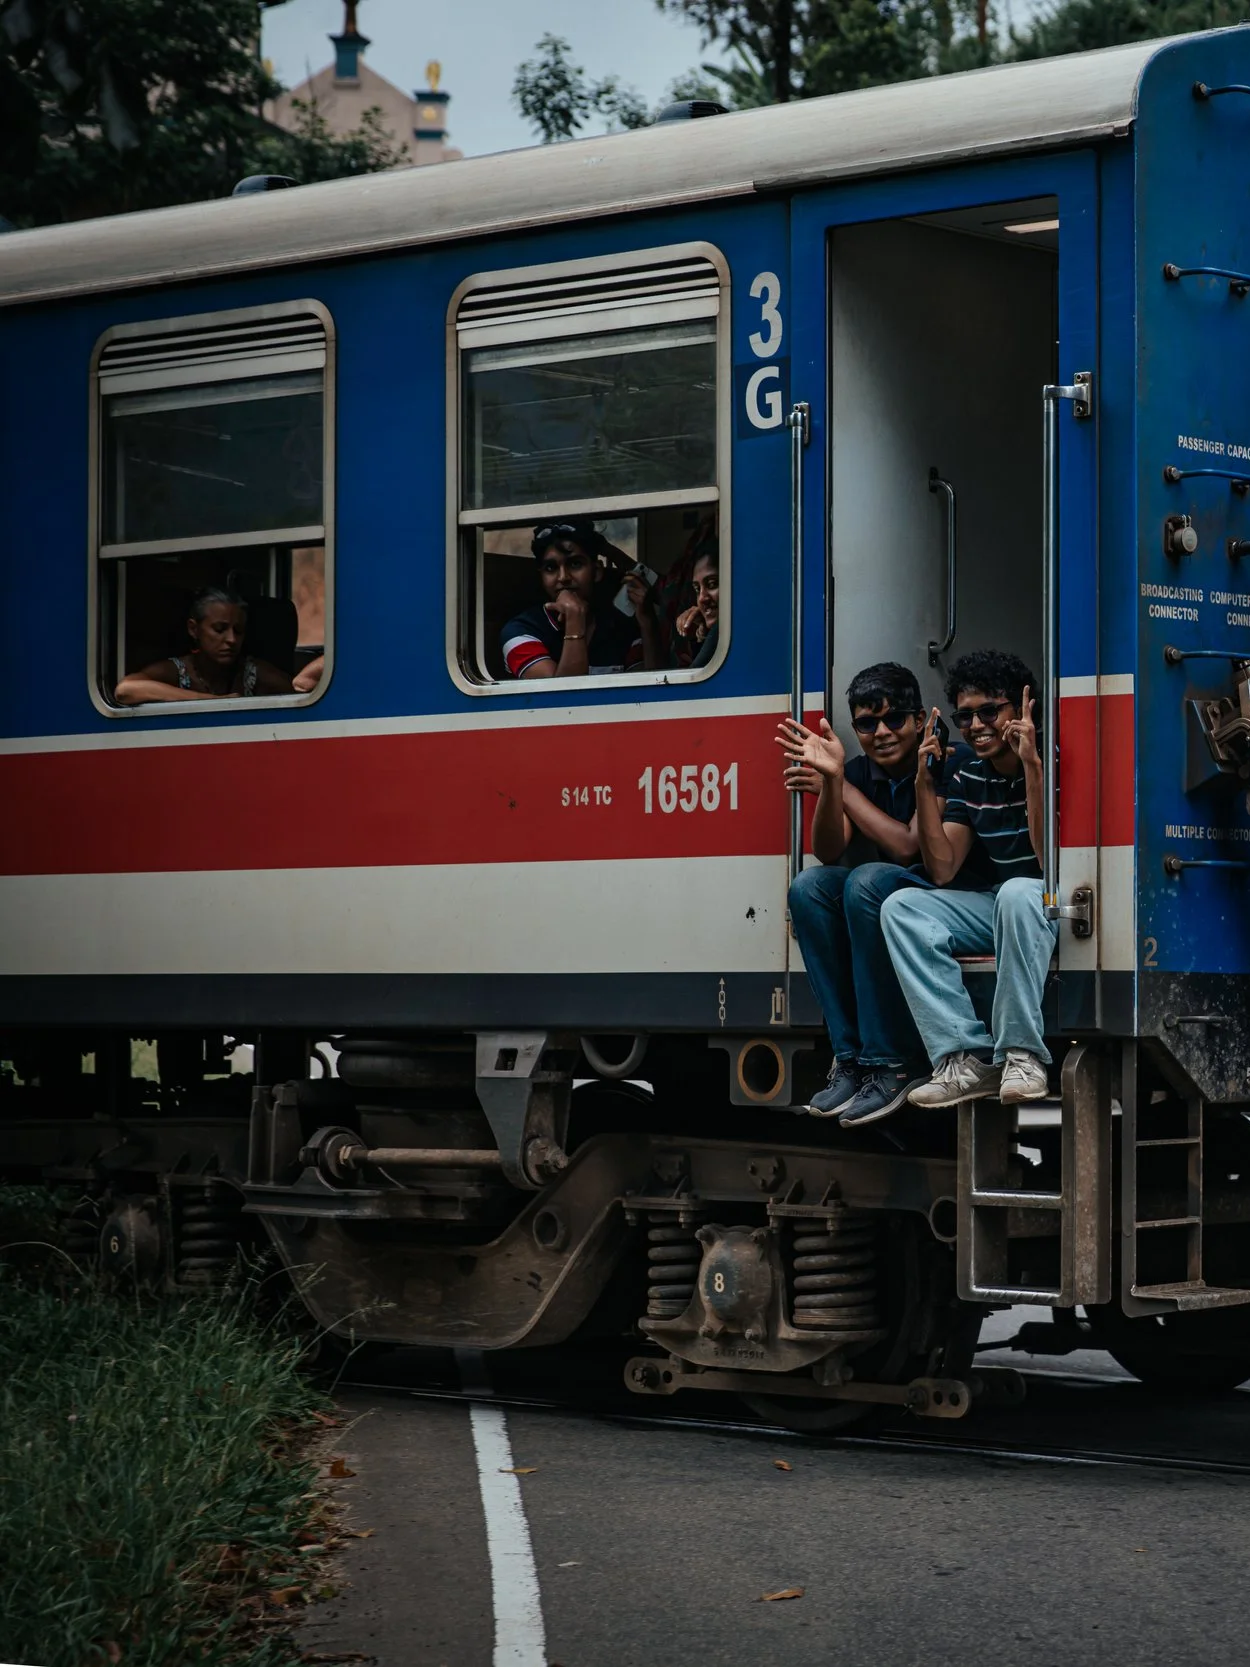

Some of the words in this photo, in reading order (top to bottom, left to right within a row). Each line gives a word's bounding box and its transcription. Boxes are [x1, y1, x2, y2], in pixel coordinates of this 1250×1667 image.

[748, 271, 783, 358] 3
[745, 365, 783, 430] G
[1177, 434, 1225, 456] PASSENGER
[1140, 583, 1204, 603] BROADCASTING
[1149, 603, 1199, 623] CONNECTOR
[593, 785, 612, 806] TC
[638, 762, 739, 814] 16581
[1165, 824, 1204, 839] MULTIPLE
[1143, 936, 1159, 967] 2
[110, 1235, 120, 1253] 6
[714, 1272, 725, 1293] 8
